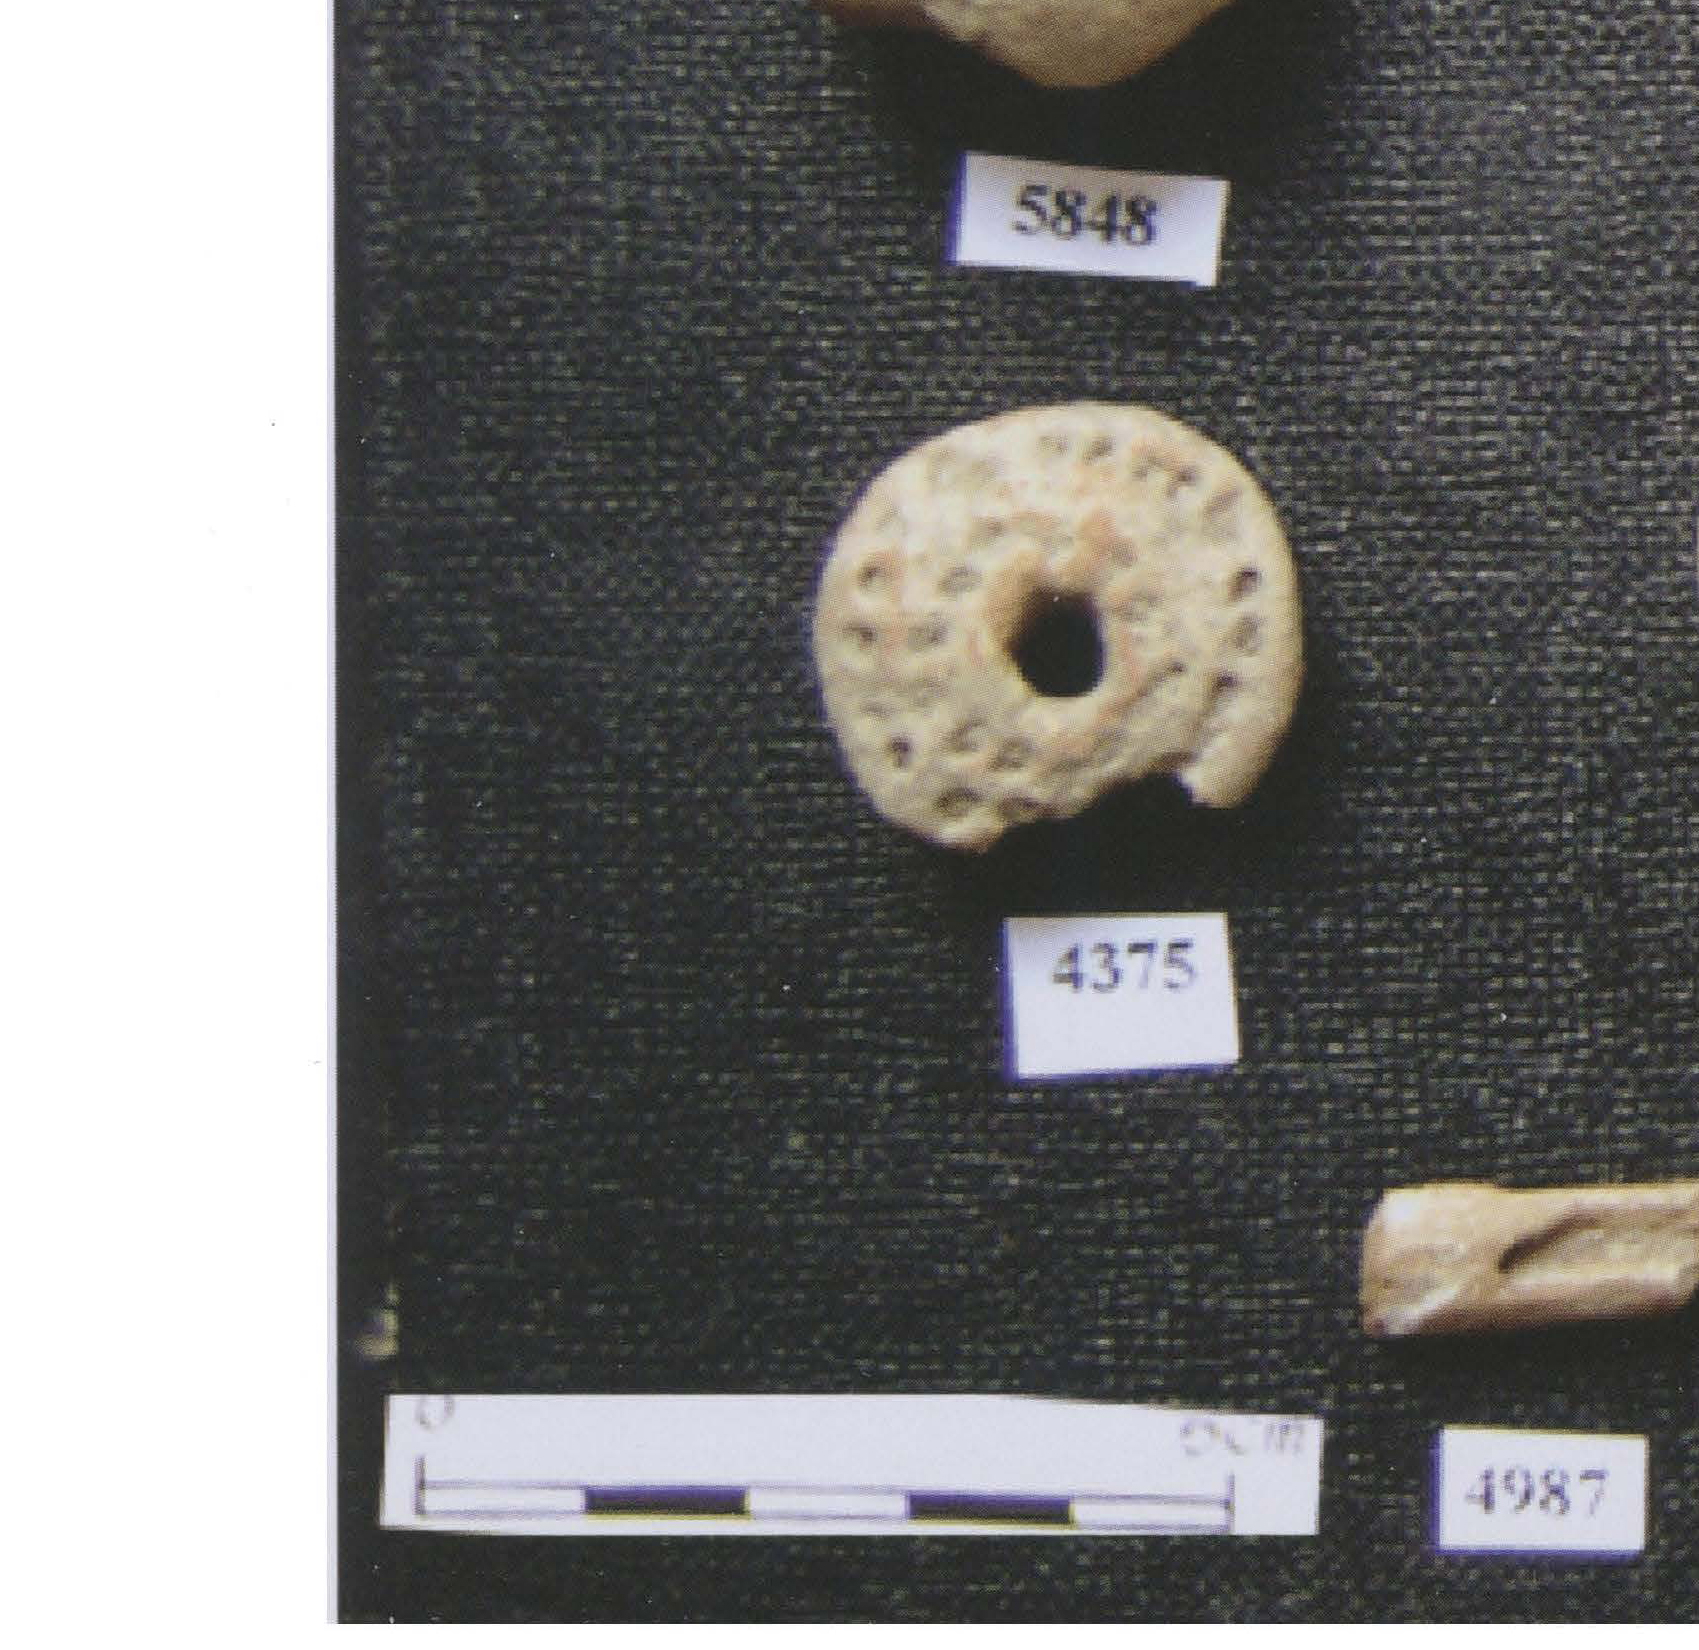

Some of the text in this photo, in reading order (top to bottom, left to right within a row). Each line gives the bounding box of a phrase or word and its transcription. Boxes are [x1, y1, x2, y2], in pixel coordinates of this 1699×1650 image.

[1011, 183, 1160, 249] 5848
[1050, 938, 1198, 994] 4375
[1464, 1466, 1610, 1516] 4987
